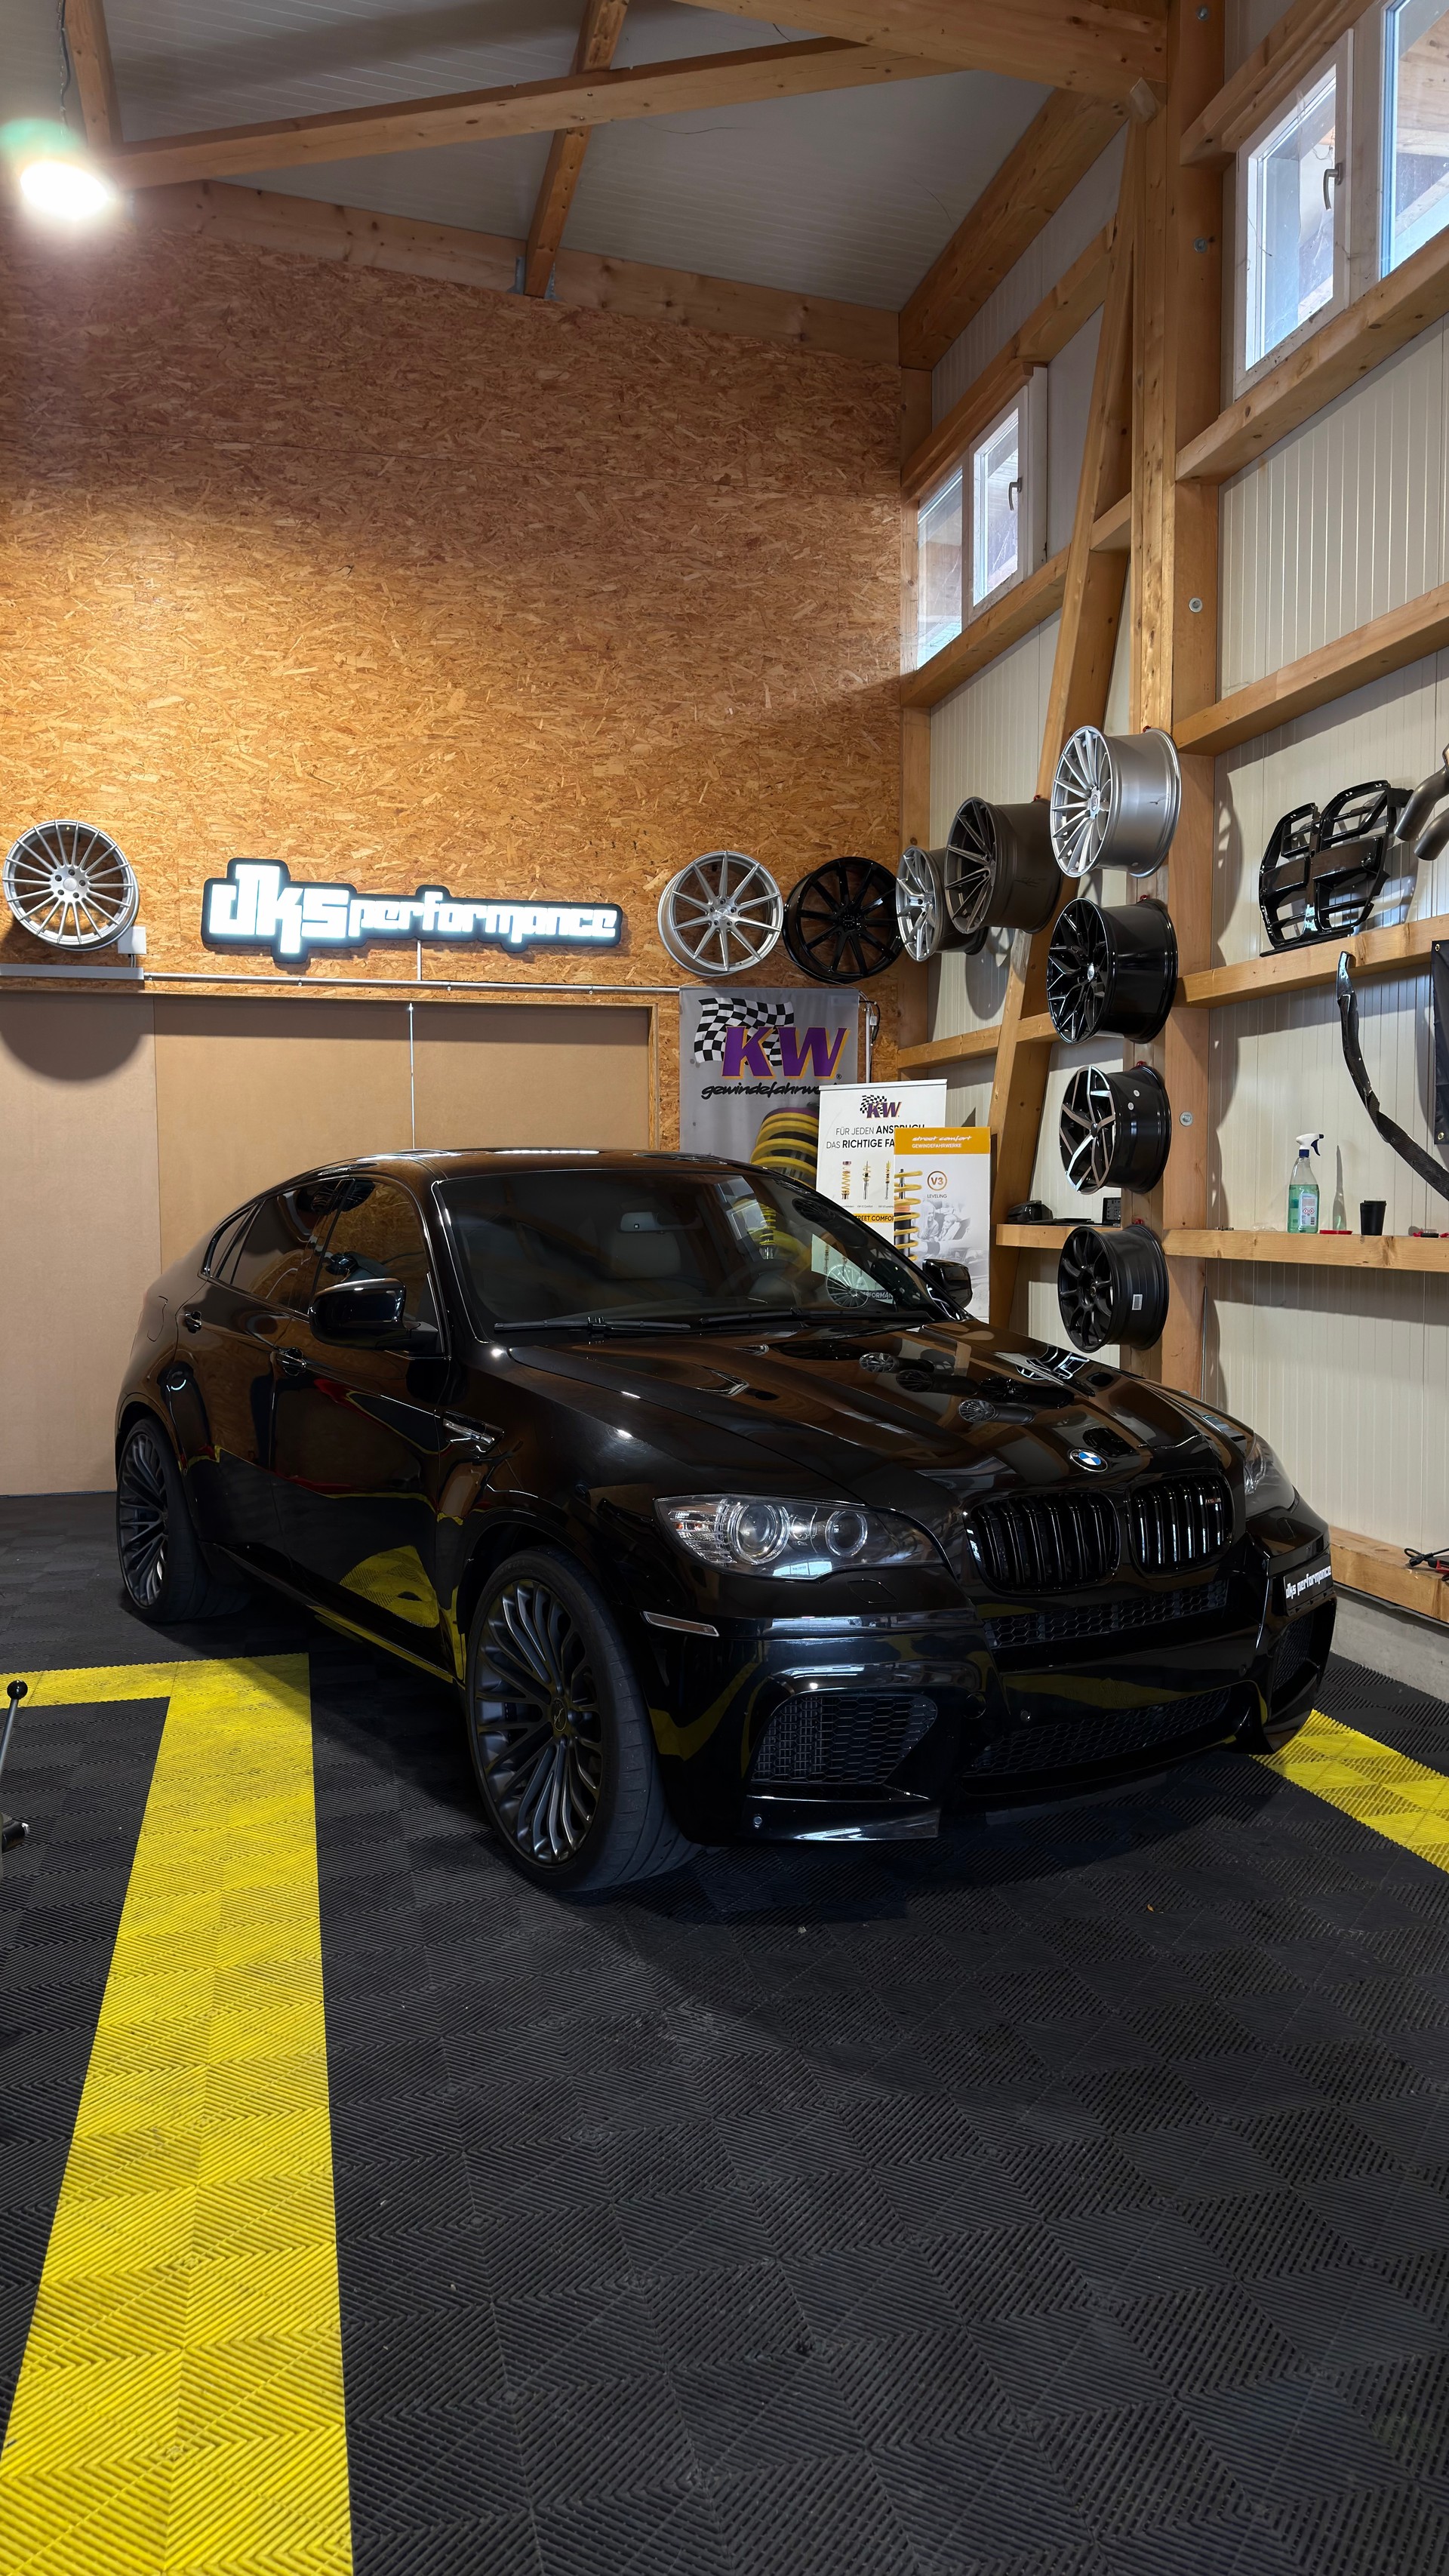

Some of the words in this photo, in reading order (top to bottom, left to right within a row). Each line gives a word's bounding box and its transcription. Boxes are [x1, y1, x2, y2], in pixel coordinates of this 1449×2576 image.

[721, 1026, 851, 1079] KW
[867, 1102, 902, 1118] KW
[835, 1127, 850, 1136] FÜR
[851, 1127, 874, 1135] JEDEN
[842, 1139, 882, 1148] RICHTIGE
[931, 1177, 943, 1185] V3
[1297, 1565, 1332, 1596] performance
